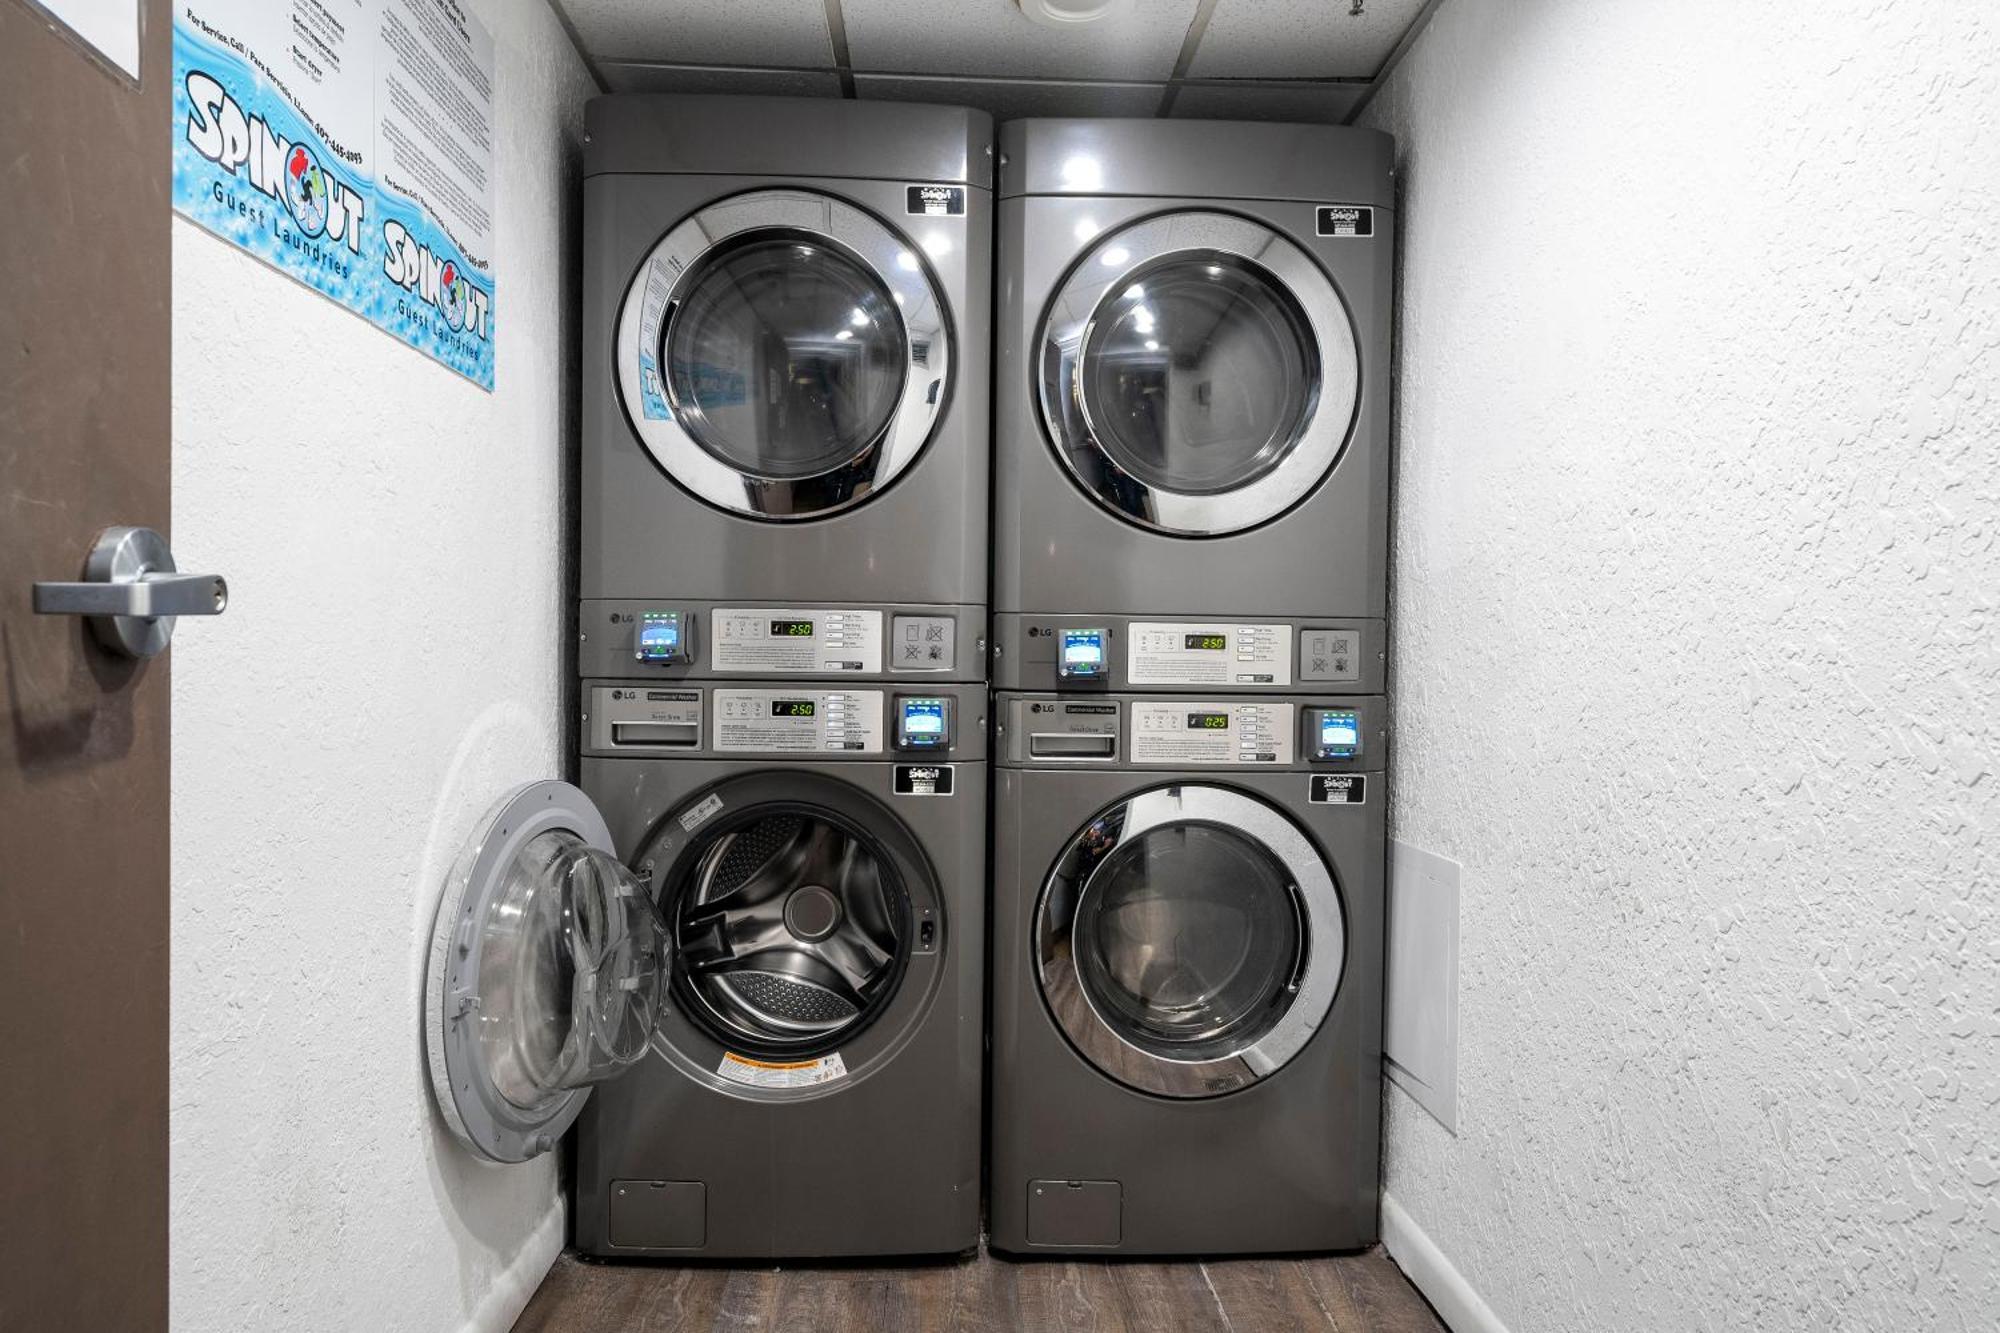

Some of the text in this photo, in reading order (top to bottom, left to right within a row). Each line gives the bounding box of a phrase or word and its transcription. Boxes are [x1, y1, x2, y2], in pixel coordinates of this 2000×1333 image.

[187, 8, 201, 27] For
[201, 20, 230, 47] Service,
[230, 37, 245, 54] Call
[250, 50, 265, 72] Para
[185, 70, 365, 256] SPINOUT
[213, 181, 350, 281] Guest Laundries
[383, 218, 489, 341] SPINOUT
[397, 298, 480, 361] Guest Laundries
[622, 614, 634, 622] LG
[1040, 628, 1052, 636] LG
